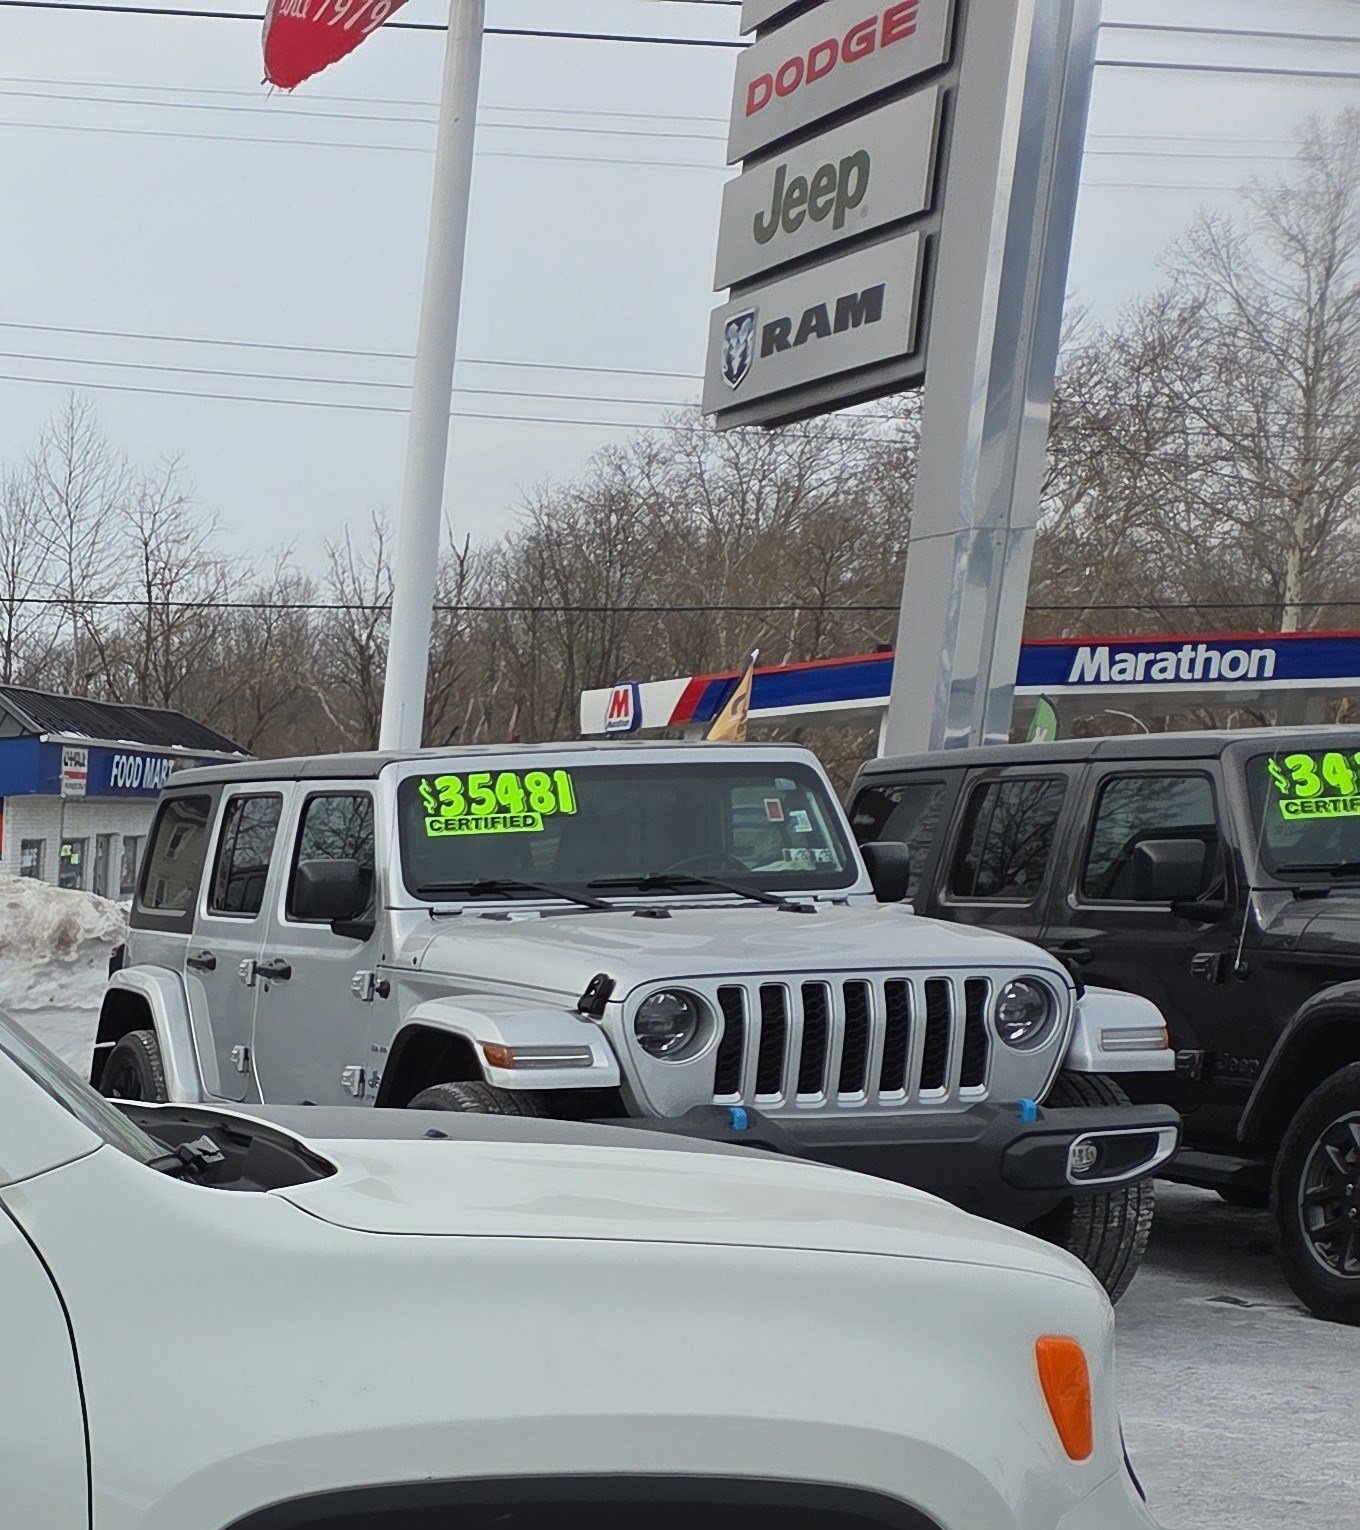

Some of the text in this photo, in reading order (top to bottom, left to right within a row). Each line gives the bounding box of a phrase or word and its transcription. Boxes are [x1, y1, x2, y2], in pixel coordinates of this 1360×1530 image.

[745, 0, 920, 117] DODGE
[753, 150, 871, 245] Jeep
[760, 283, 886, 358] RAM
[1068, 644, 1277, 683] Marathon
[109, 754, 142, 788] FOOD
[418, 769, 578, 817] $35481
[1268, 751, 1360, 797] $34
[429, 815, 536, 832] CERTIFIED
